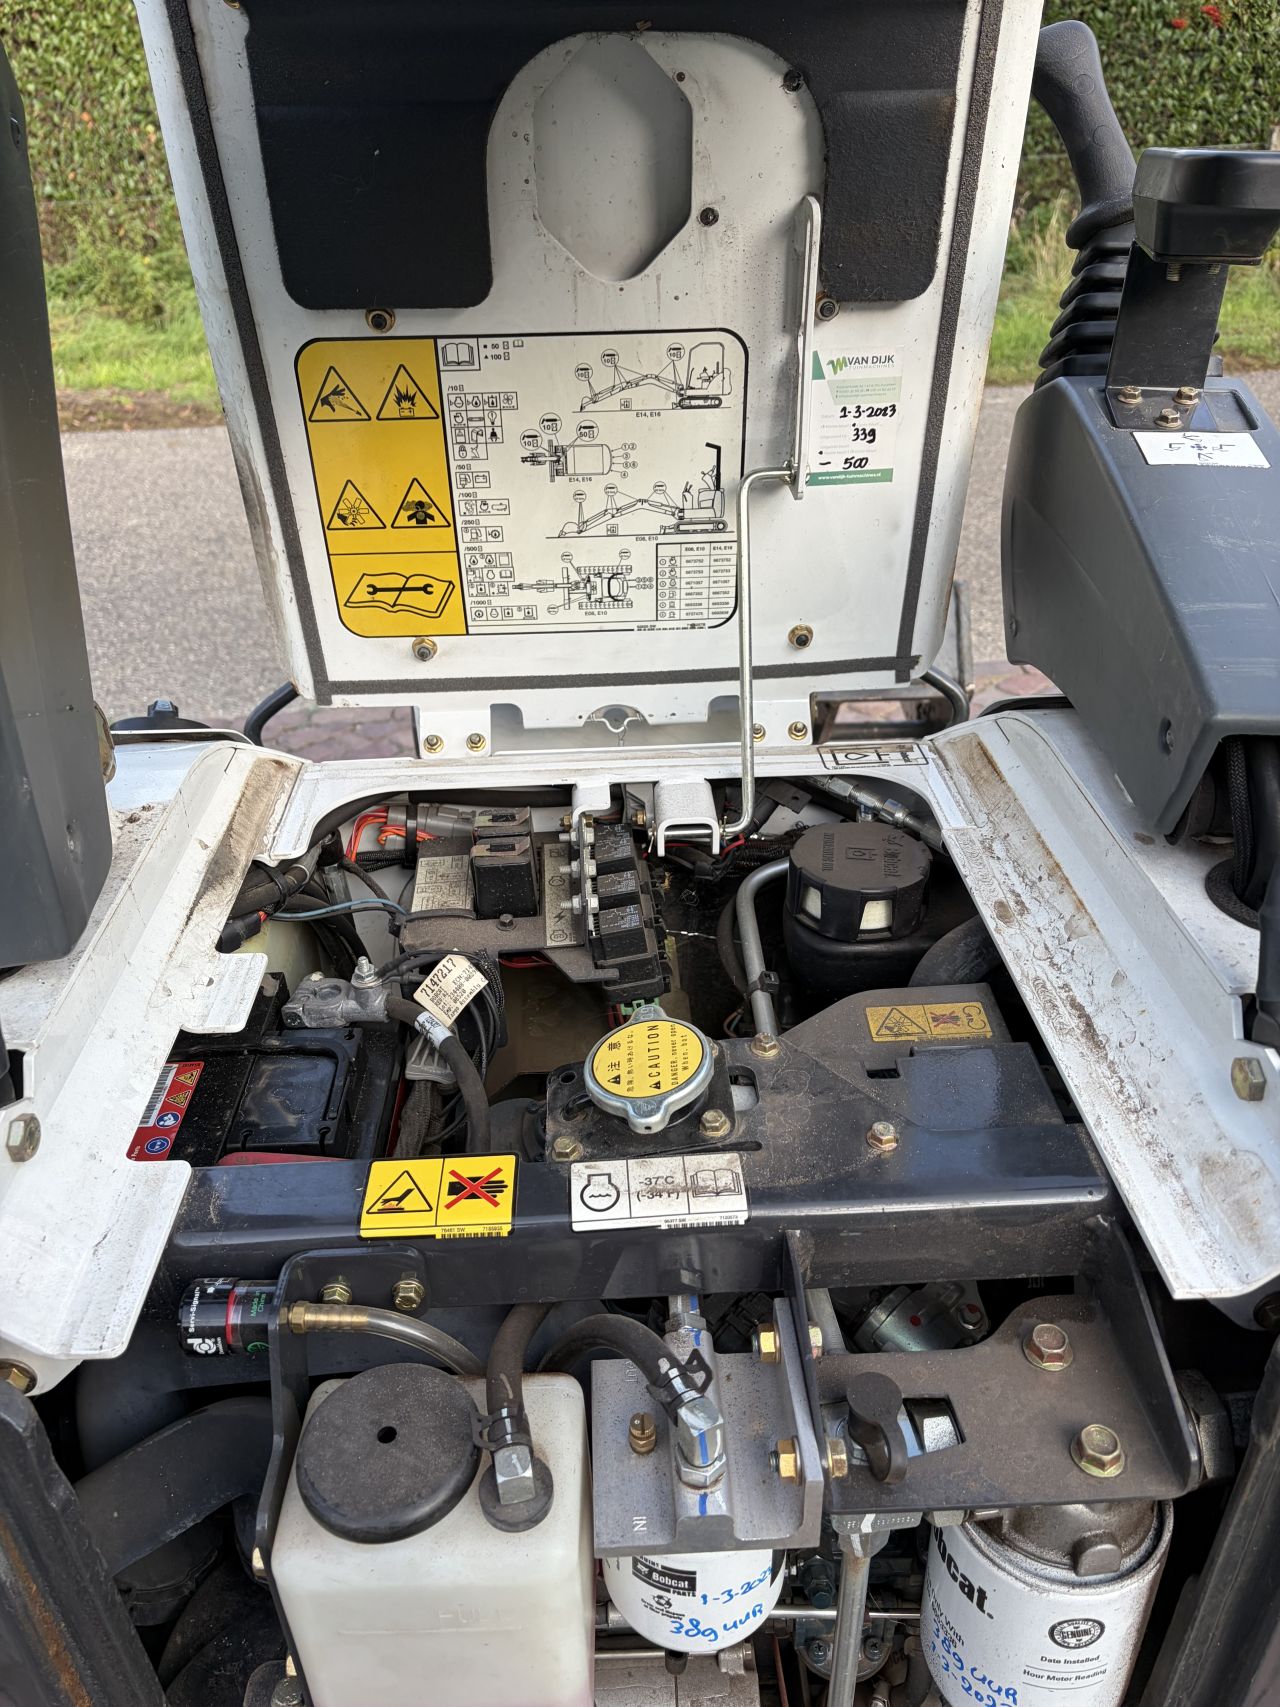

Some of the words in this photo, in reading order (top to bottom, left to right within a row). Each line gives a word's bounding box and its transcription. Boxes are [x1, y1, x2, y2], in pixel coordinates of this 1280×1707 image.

[847, 355, 869, 366] VAN
[871, 354, 895, 364] DIJK
[842, 456, 869, 470] 500
[419, 957, 458, 998] 7147217
[647, 1024, 661, 1078] CAUTION
[250, 1298, 259, 1317] Made
[257, 1293, 267, 1312] China
[632, 1516, 647, 1532] IN
[652, 1572, 689, 1588] Bobcat
[1040, 1655, 1061, 1665] Date
[1063, 1654, 1101, 1665] Installed
[1023, 1669, 1044, 1680] Hour
[1046, 1672, 1073, 1682] Meter
[1074, 1668, 1107, 1682] Reading
